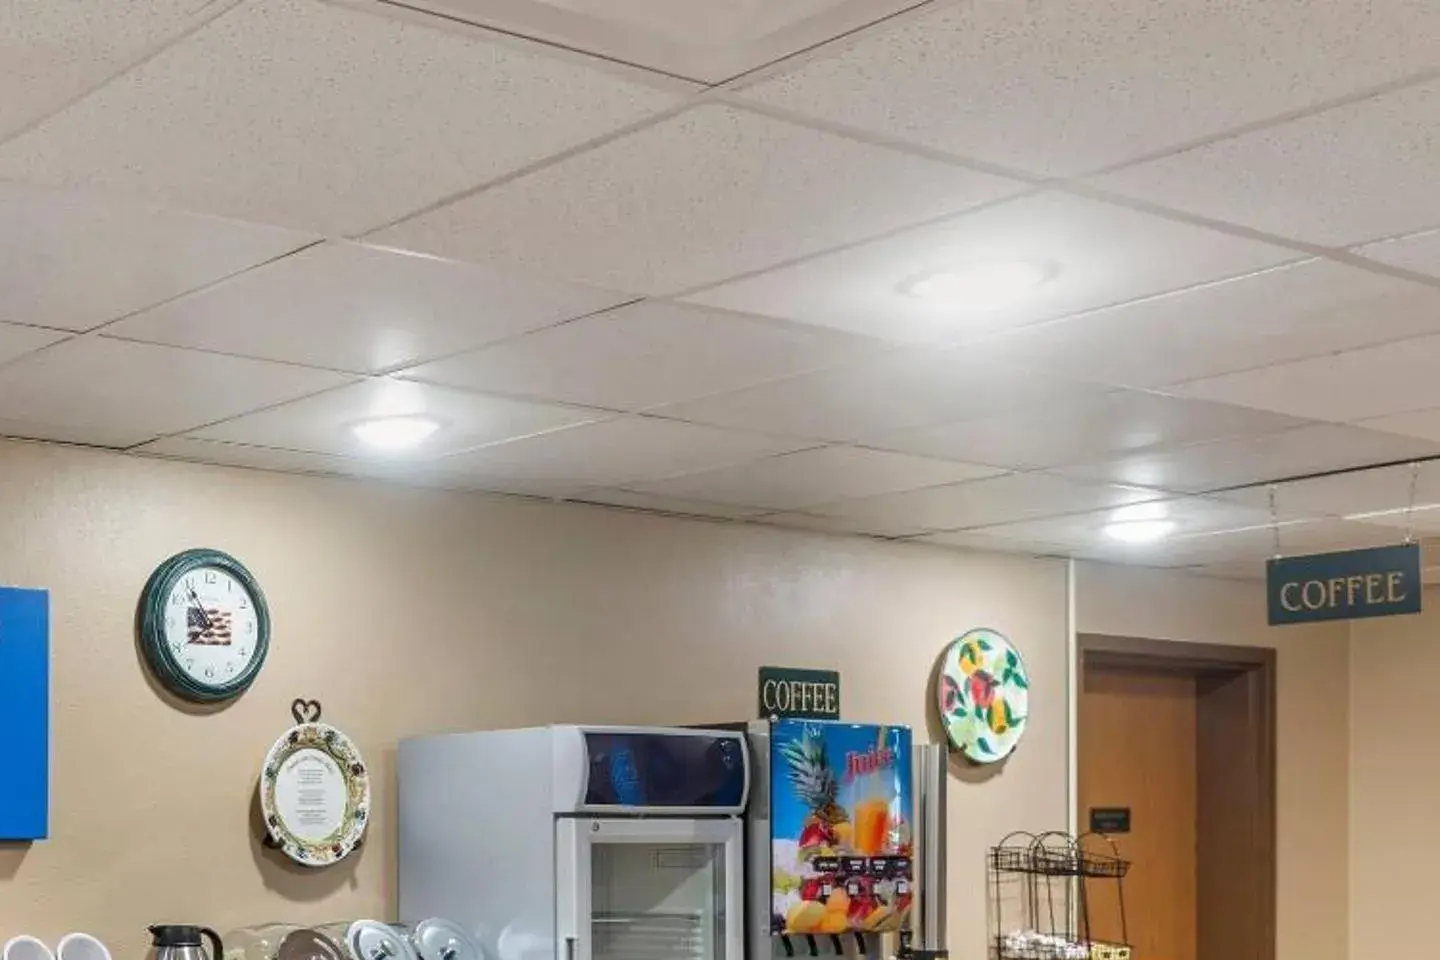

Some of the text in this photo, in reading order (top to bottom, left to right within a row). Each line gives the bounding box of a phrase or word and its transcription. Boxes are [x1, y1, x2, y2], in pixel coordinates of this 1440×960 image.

[204, 571, 217, 585] 12
[1280, 572, 1406, 612] COFFEE
[763, 680, 837, 713] COFFEE
